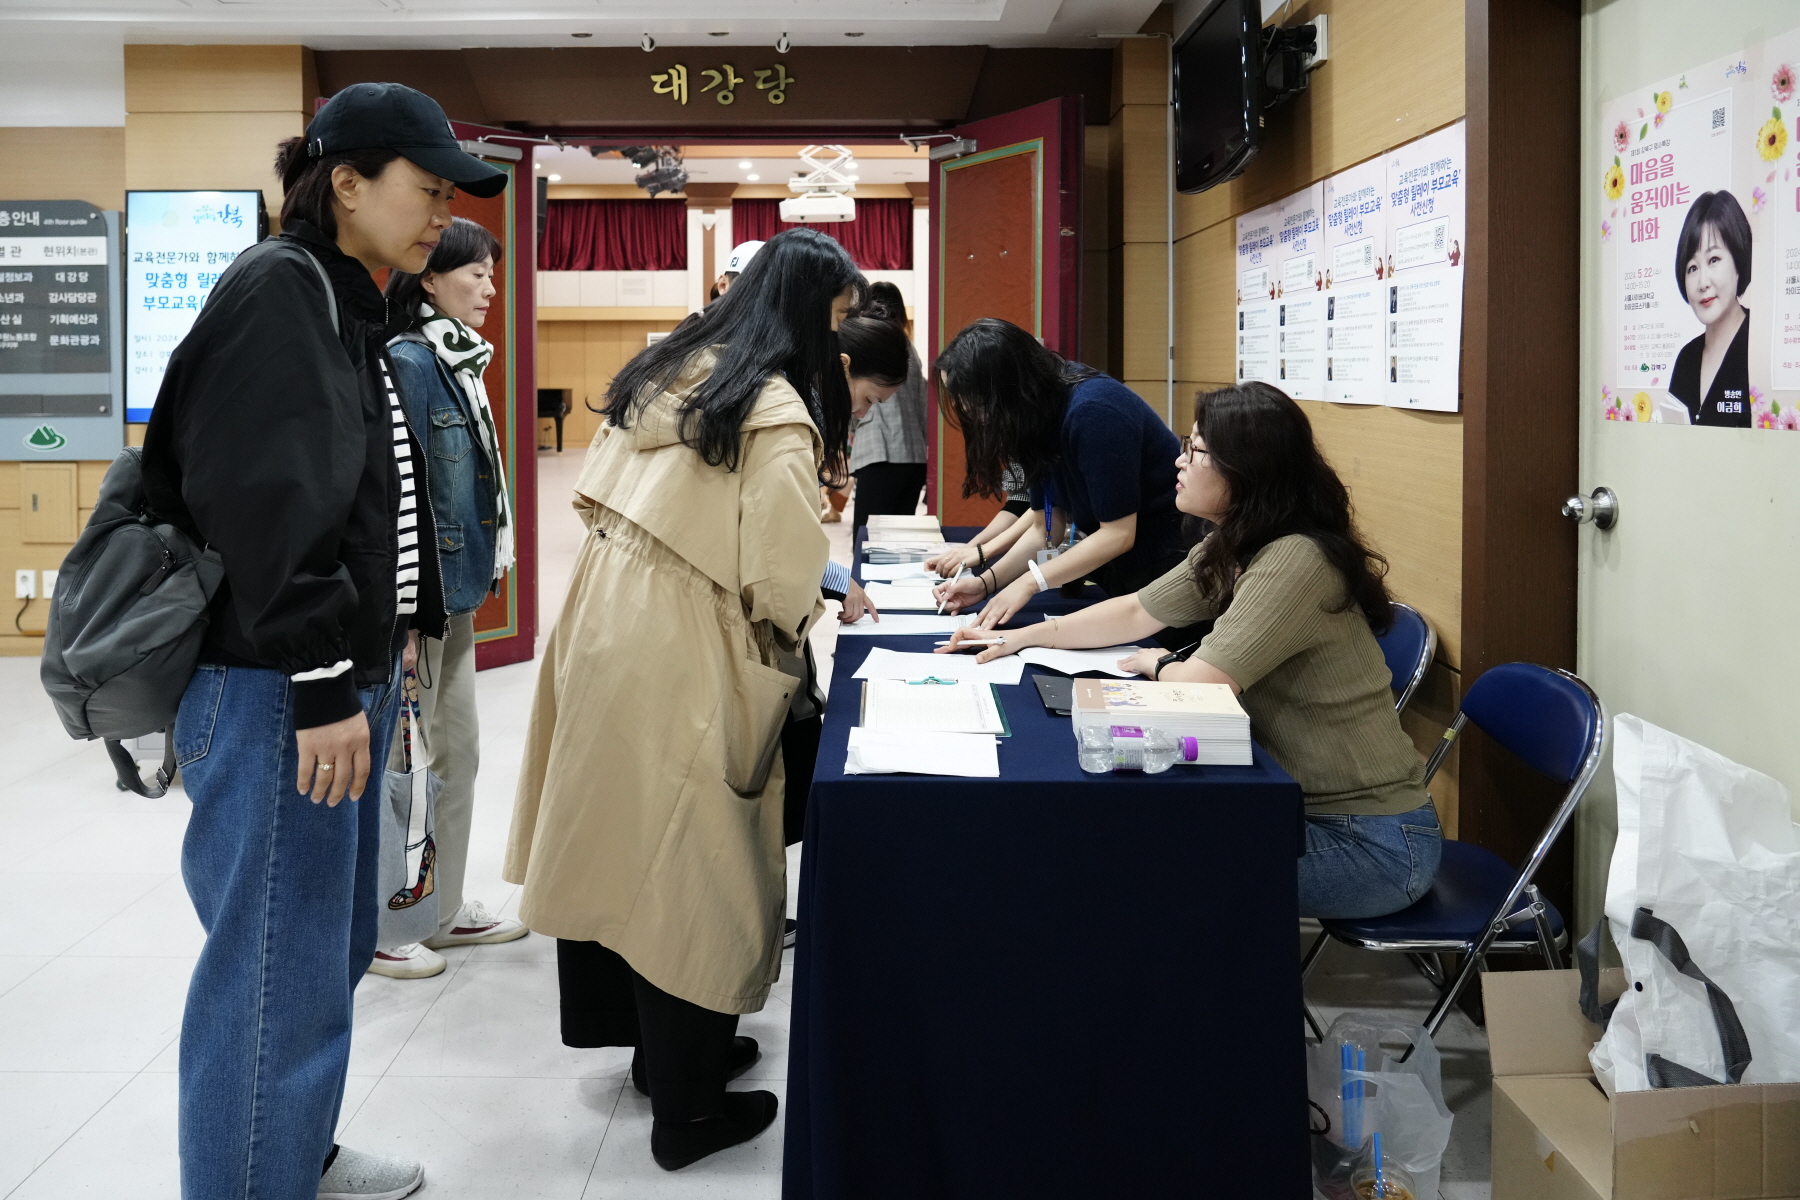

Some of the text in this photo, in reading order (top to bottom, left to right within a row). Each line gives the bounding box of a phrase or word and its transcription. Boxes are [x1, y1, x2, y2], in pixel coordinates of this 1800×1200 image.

[650, 64, 795, 105] 대강당
[1398, 157, 1452, 186] 교육전문가와 함께하는
[1630, 154, 1674, 186] 마음을
[1334, 185, 1374, 208] 교육전문가와 함께하는
[1411, 180, 1430, 202] 릴레이
[1630, 182, 1690, 214] 움직이는
[217, 204, 242, 228] 강북
[1344, 204, 1358, 223] 릴레이
[1410, 197, 1434, 216] 사전신청
[1344, 220, 1362, 236] 사전신청
[1630, 217, 1660, 243] 대화
[133, 252, 200, 264] 교육전문가와
[146, 272, 188, 288] 맞춤형
[48, 292, 98, 304] 감사담당관
[50, 314, 98, 326] 기획예산과
[49, 335, 100, 346] 문화관광과
[1724, 390, 1742, 398] 방송인
[1716, 402, 1742, 413] 이금희
